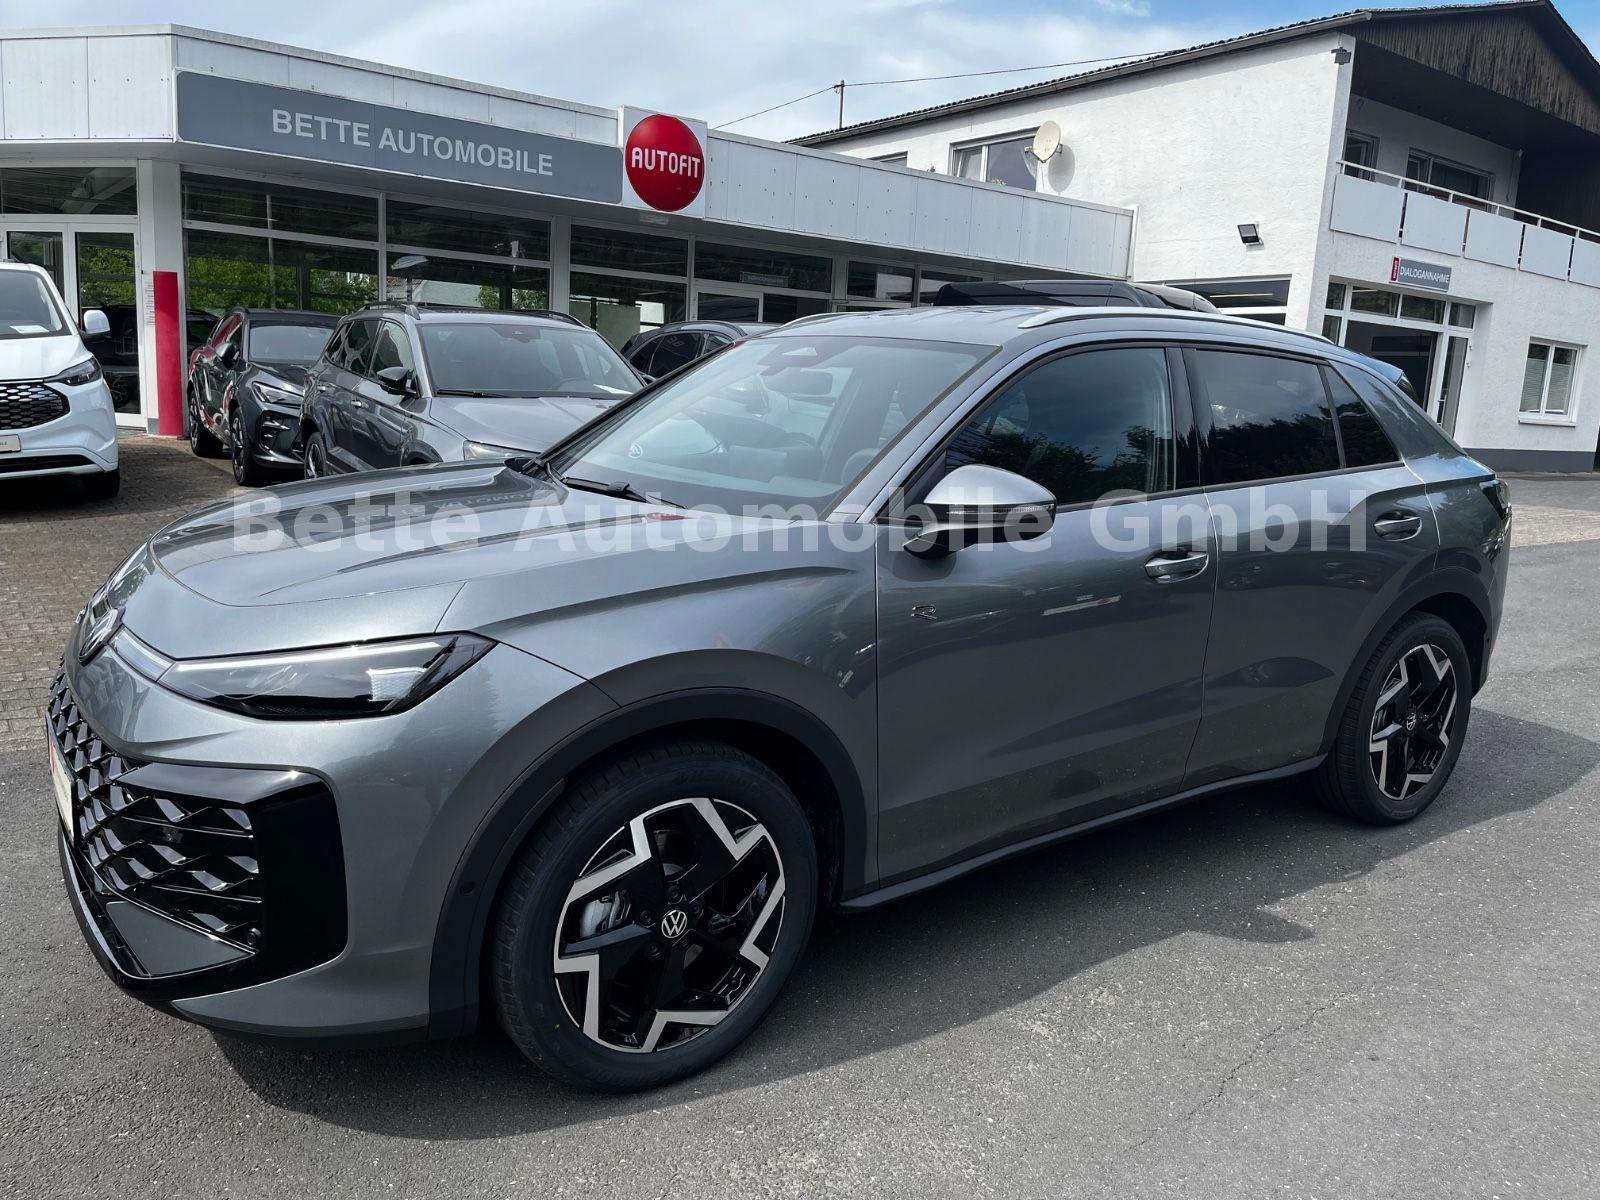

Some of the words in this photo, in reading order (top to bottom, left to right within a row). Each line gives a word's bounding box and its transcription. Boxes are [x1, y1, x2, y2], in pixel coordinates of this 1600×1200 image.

[272, 108, 371, 147] BETTE
[378, 127, 553, 176] AUTOMOBILE
[631, 147, 701, 178] AUTOFIT
[1399, 266, 1450, 284] DIALOGANNAHME
